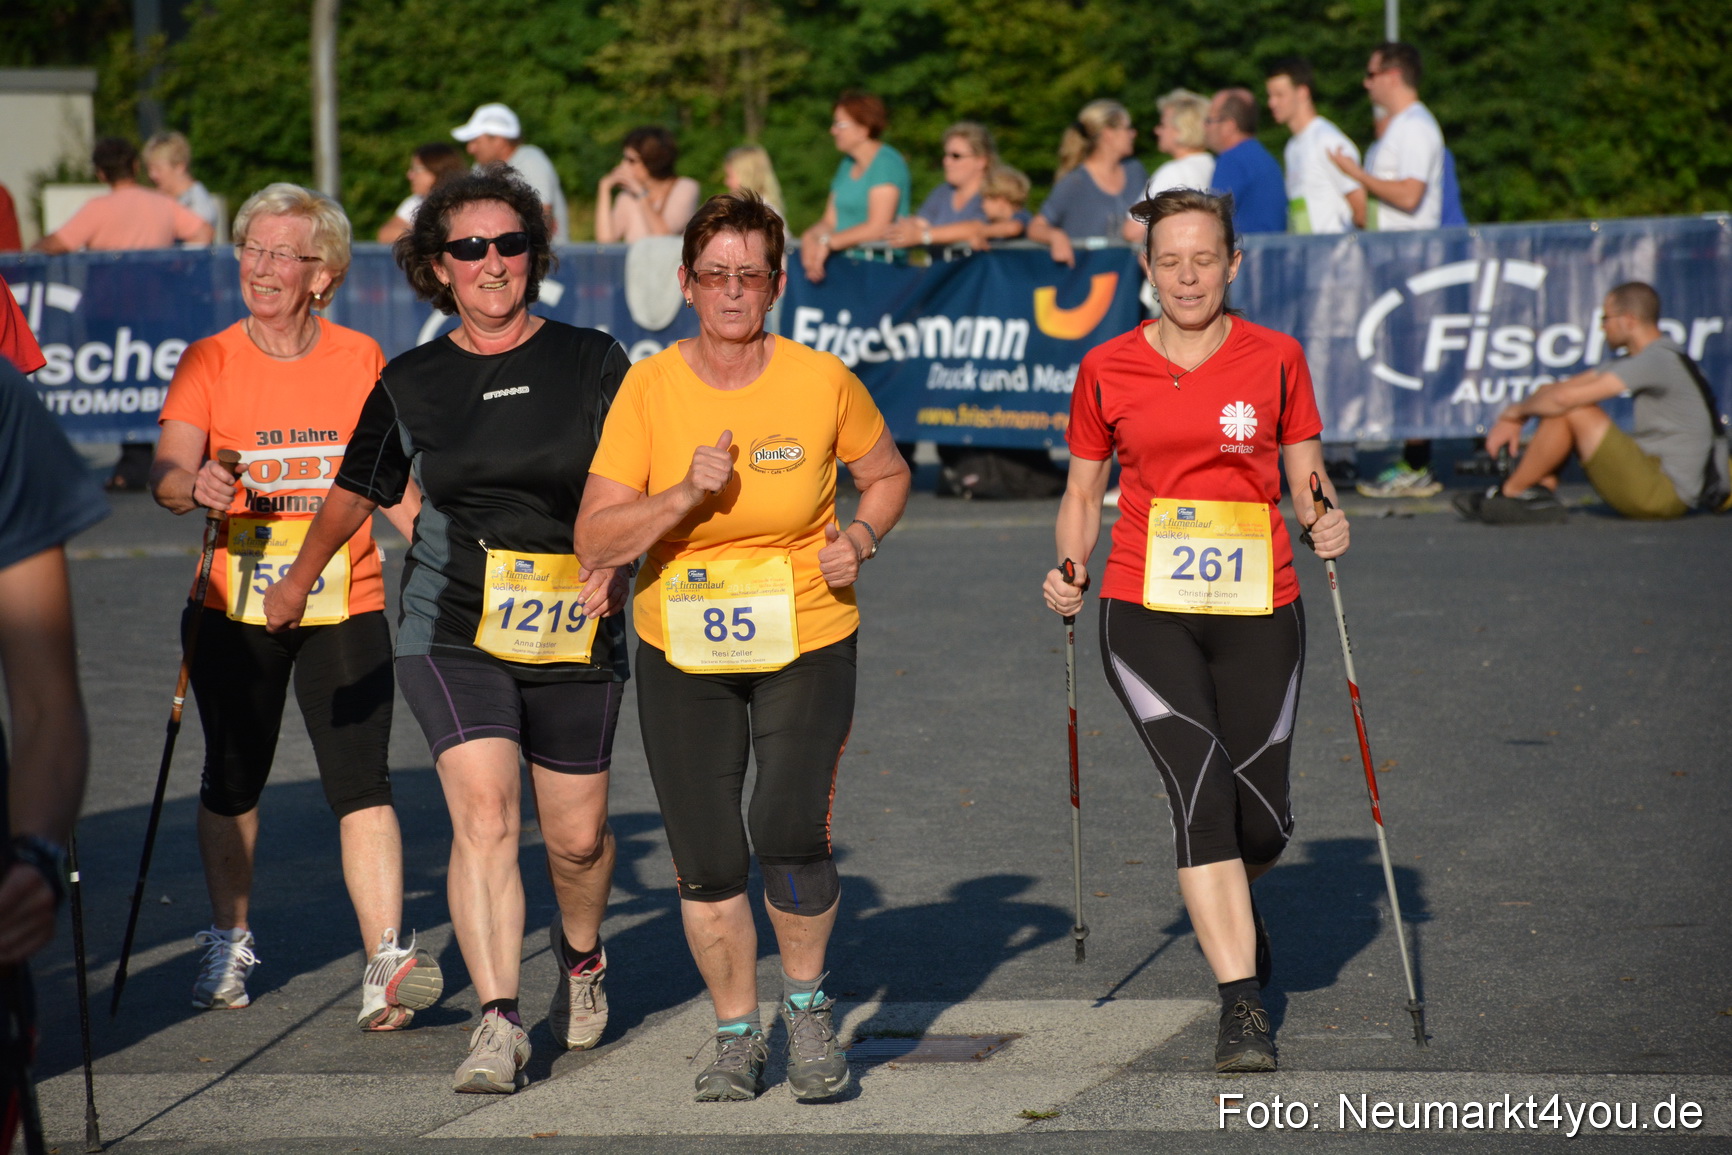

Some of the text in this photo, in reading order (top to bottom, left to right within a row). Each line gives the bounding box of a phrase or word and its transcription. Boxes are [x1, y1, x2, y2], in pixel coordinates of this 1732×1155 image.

[793, 306, 1030, 368] Frischmann
[27, 326, 190, 385] sche
[926, 361, 1080, 393] Druck und Med
[483, 386, 530, 400] STANNO
[1452, 375, 1570, 404] AUTO
[256, 428, 339, 446] 30 Jahre
[755, 447, 788, 463] plank
[1220, 443, 1254, 454] caritas
[245, 488, 323, 513] Neuma
[1168, 518, 1212, 528] firmenlauf
[1155, 530, 1190, 540] walken
[1171, 545, 1243, 582] 261
[506, 569, 550, 581] firmenlauf
[492, 582, 527, 593] walken
[680, 580, 725, 589] firmenlauf
[668, 593, 704, 602] walken
[1179, 589, 1238, 599] Christine Simon
[498, 597, 588, 633] 1219
[703, 606, 756, 642] 85
[514, 639, 557, 649] Anna Distler
